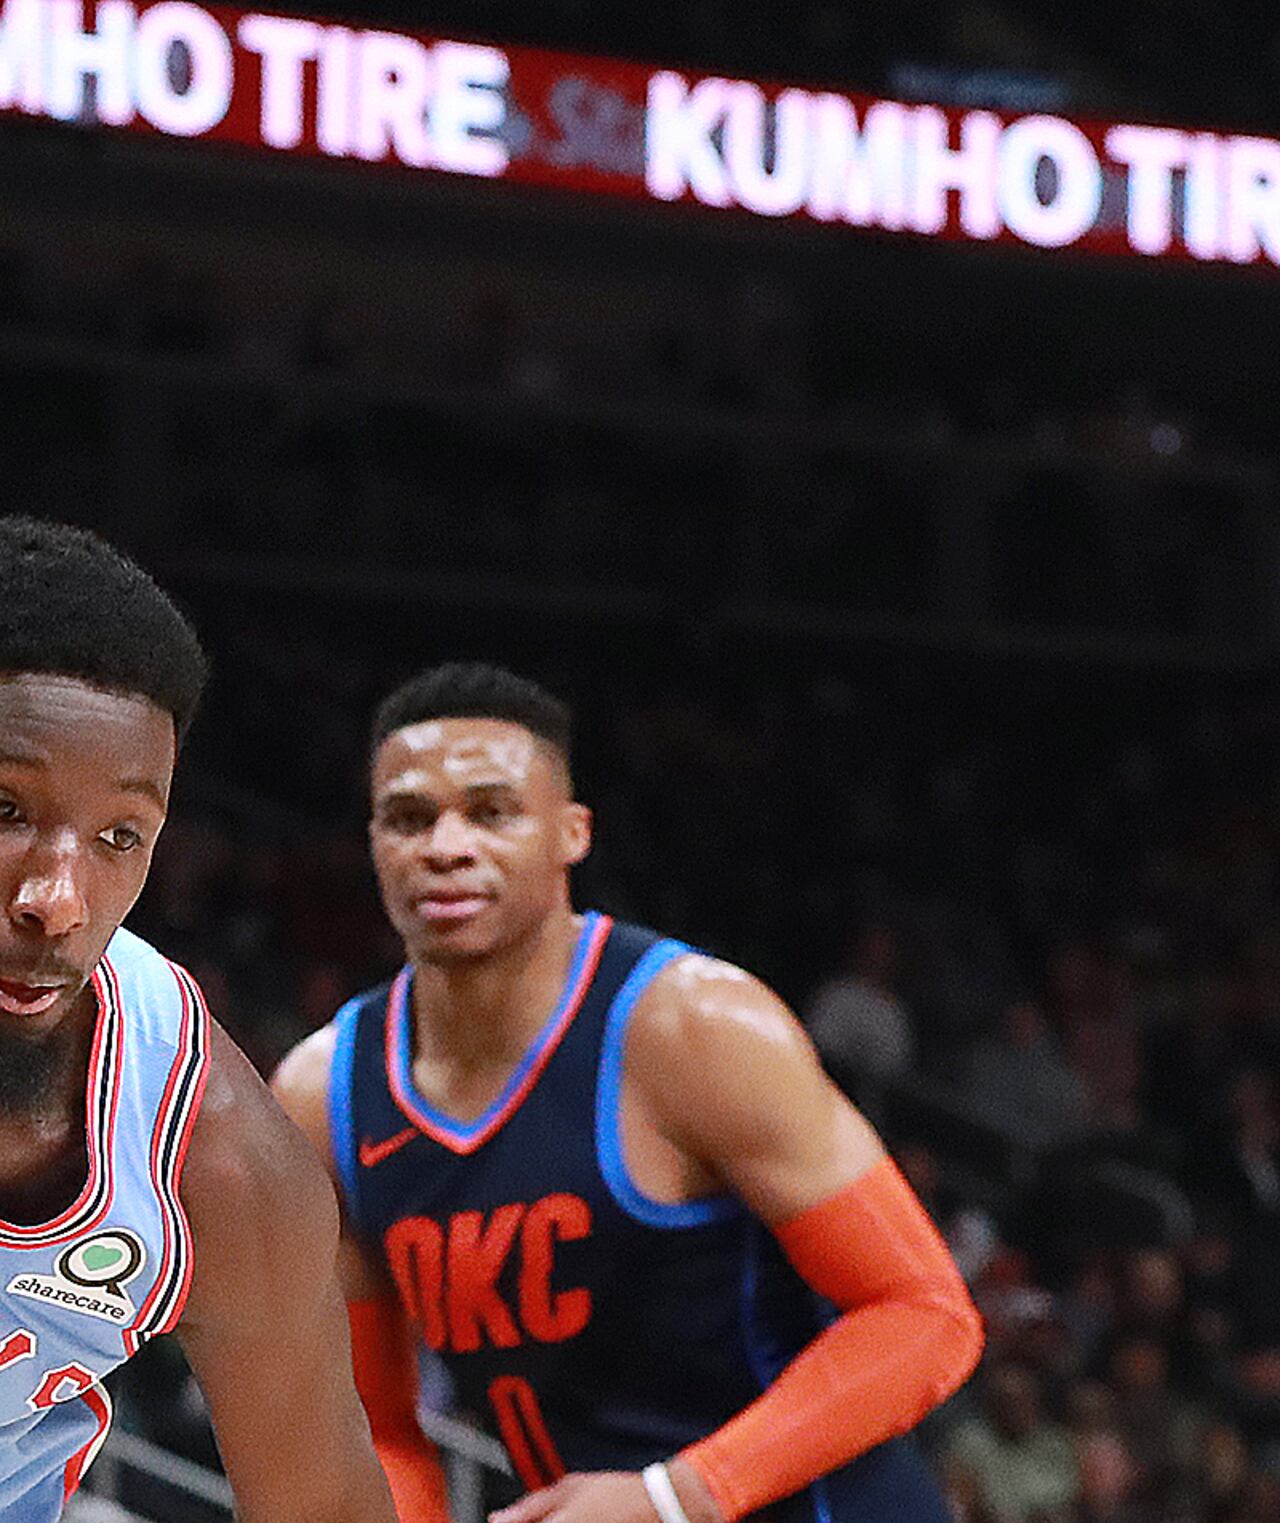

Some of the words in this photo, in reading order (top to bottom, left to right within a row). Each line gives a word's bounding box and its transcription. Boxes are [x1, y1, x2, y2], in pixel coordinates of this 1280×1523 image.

[239, 13, 511, 177] TIRE
[645, 69, 1102, 248] KUMHO
[14, 1278, 126, 1320] sharecare
[384, 1192, 592, 1353] OKC
